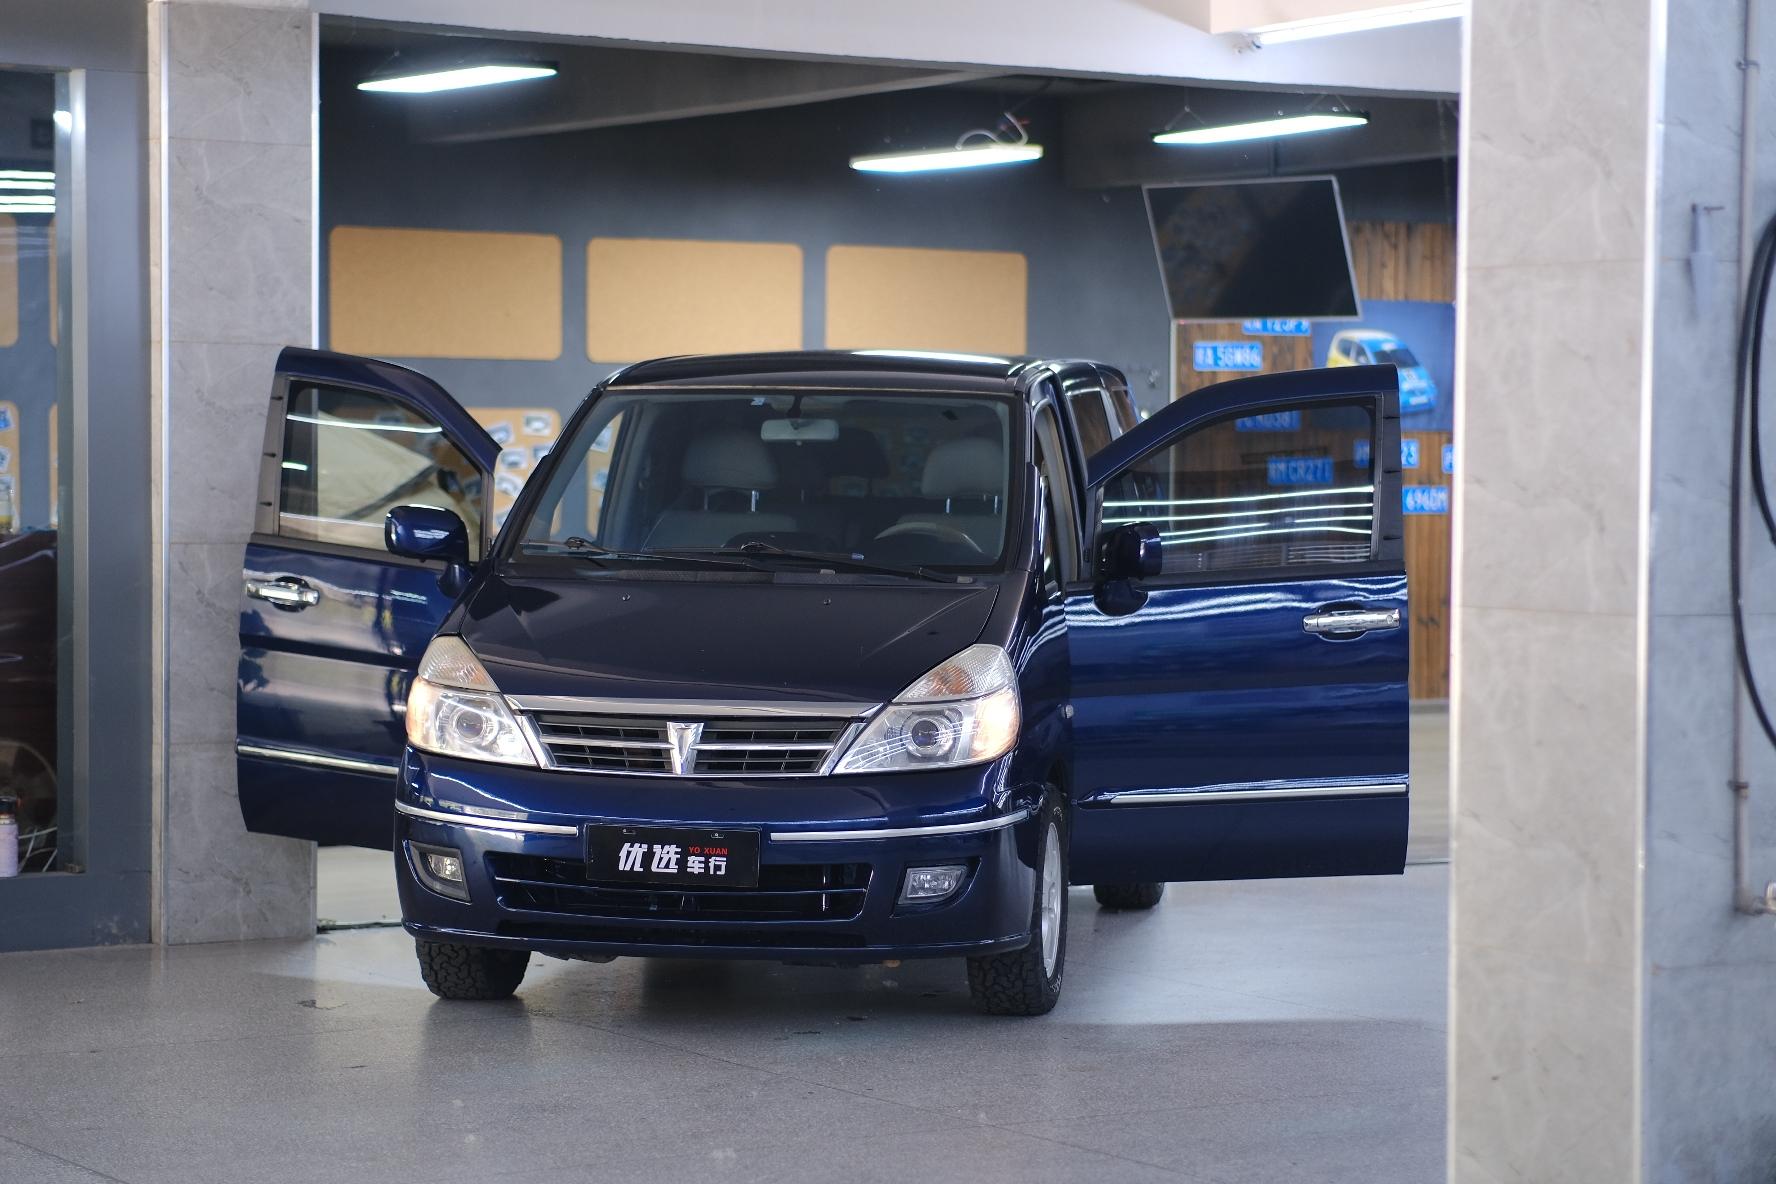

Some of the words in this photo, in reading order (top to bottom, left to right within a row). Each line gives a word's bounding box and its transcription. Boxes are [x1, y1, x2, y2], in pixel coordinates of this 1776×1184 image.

[618, 842, 682, 873] 优选
[686, 855, 728, 875] 车行
[688, 846, 700, 854] YO
[703, 847, 728, 855] XUAN
